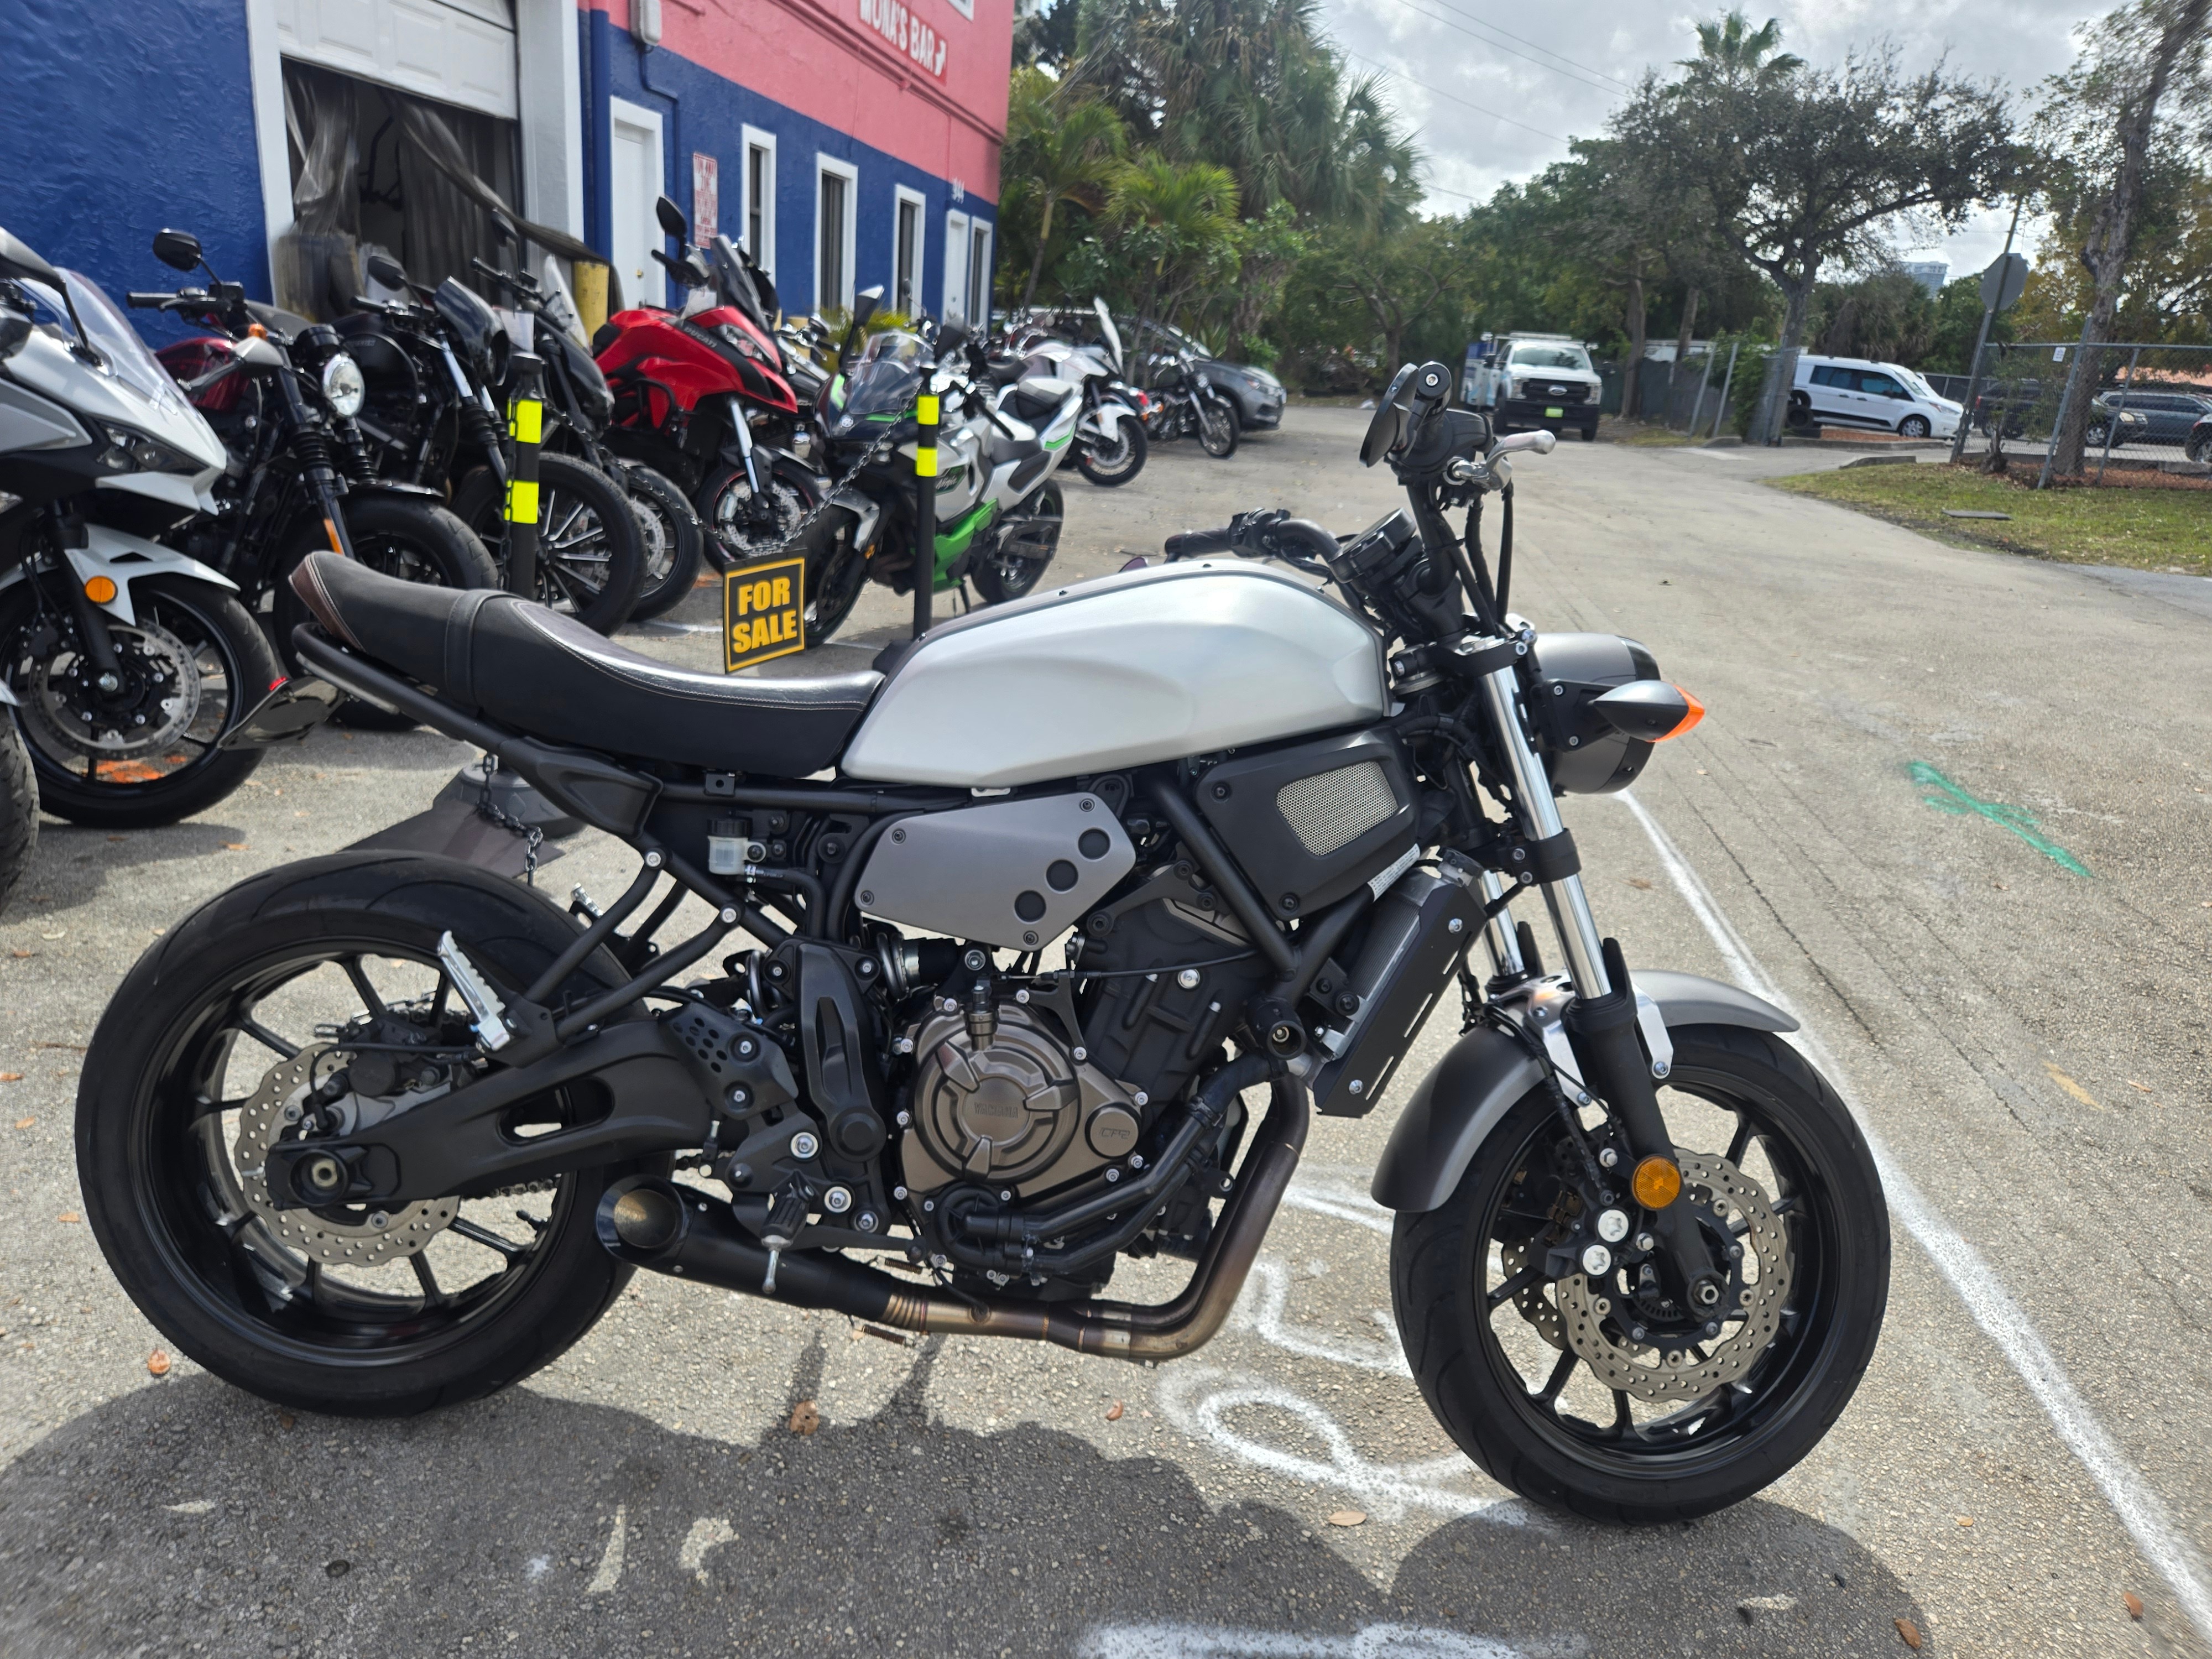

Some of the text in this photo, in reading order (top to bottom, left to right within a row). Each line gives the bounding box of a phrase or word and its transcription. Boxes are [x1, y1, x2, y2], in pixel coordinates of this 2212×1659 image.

[910, 15, 935, 73] BAR
[684, 327, 717, 348] DUCATI
[738, 576, 791, 616] FOR
[733, 610, 797, 654] SALE
